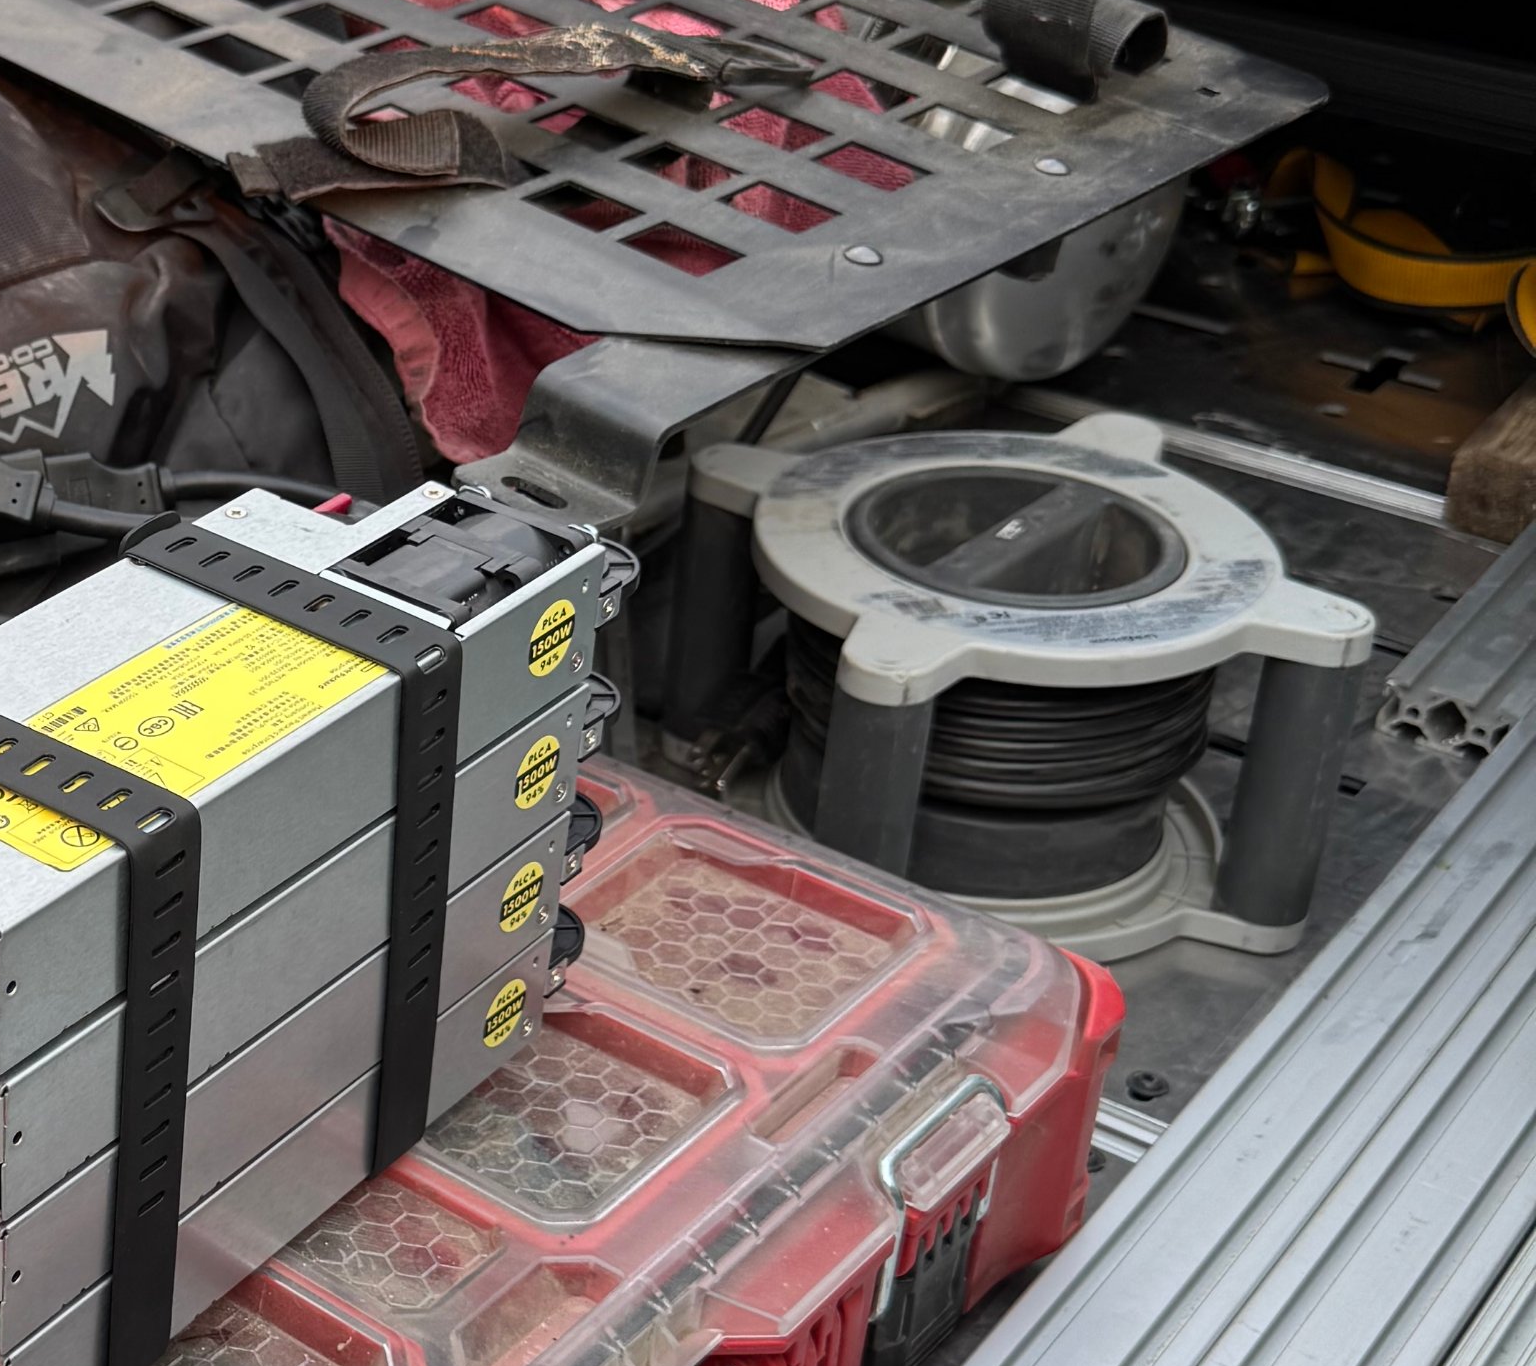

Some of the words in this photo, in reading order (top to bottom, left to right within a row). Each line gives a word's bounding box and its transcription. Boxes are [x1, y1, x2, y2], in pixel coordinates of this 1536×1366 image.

[542, 612, 560, 631] PLC
[559, 607, 567, 619] A
[531, 620, 574, 659] 1500W
[540, 653, 560, 671] 94%
[527, 748, 544, 766] PLC
[544, 742, 552, 753] A
[517, 754, 558, 795] 1500W
[525, 785, 544, 804] 94%
[514, 873, 530, 891] PLC
[529, 869, 537, 879] A
[503, 881, 541, 917] 1500W
[510, 911, 527, 927] 94%
[497, 990, 511, 1009] PLC
[511, 986, 519, 995] A
[487, 996, 524, 1033] 1500W
[494, 1024, 511, 1043] 94%
